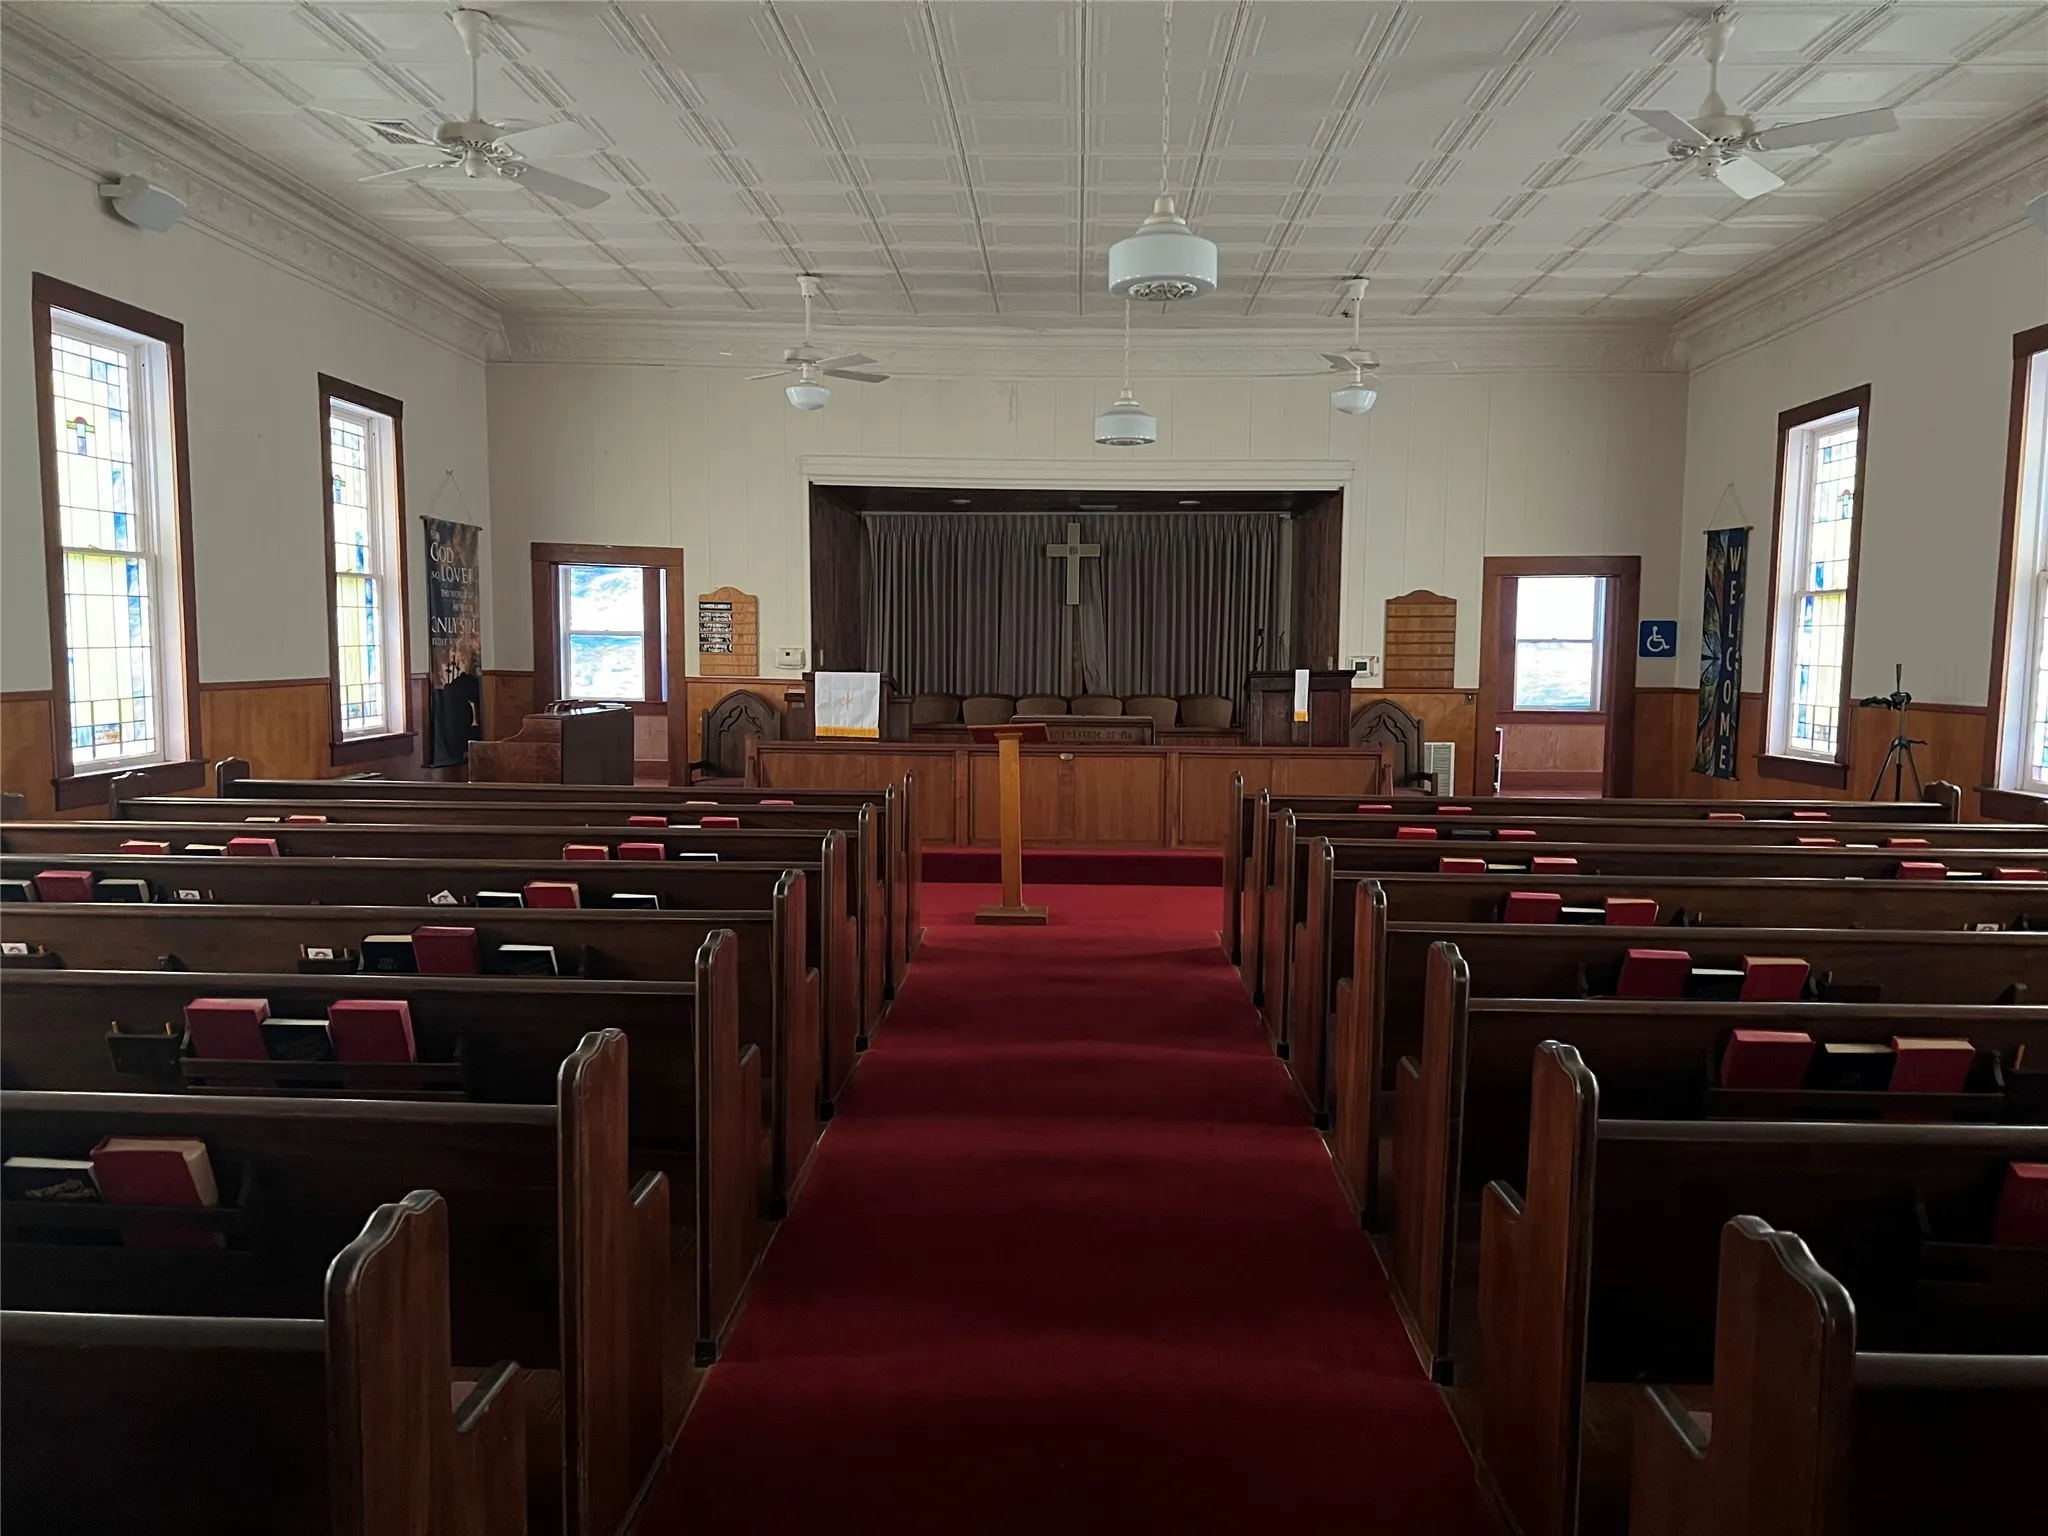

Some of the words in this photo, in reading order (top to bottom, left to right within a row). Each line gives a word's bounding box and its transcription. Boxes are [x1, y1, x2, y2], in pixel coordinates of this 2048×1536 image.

[431, 615, 458, 633] ONLY
[1718, 546, 1742, 769] WELCOME
[1050, 730, 1102, 740] EMEMBRANCE
